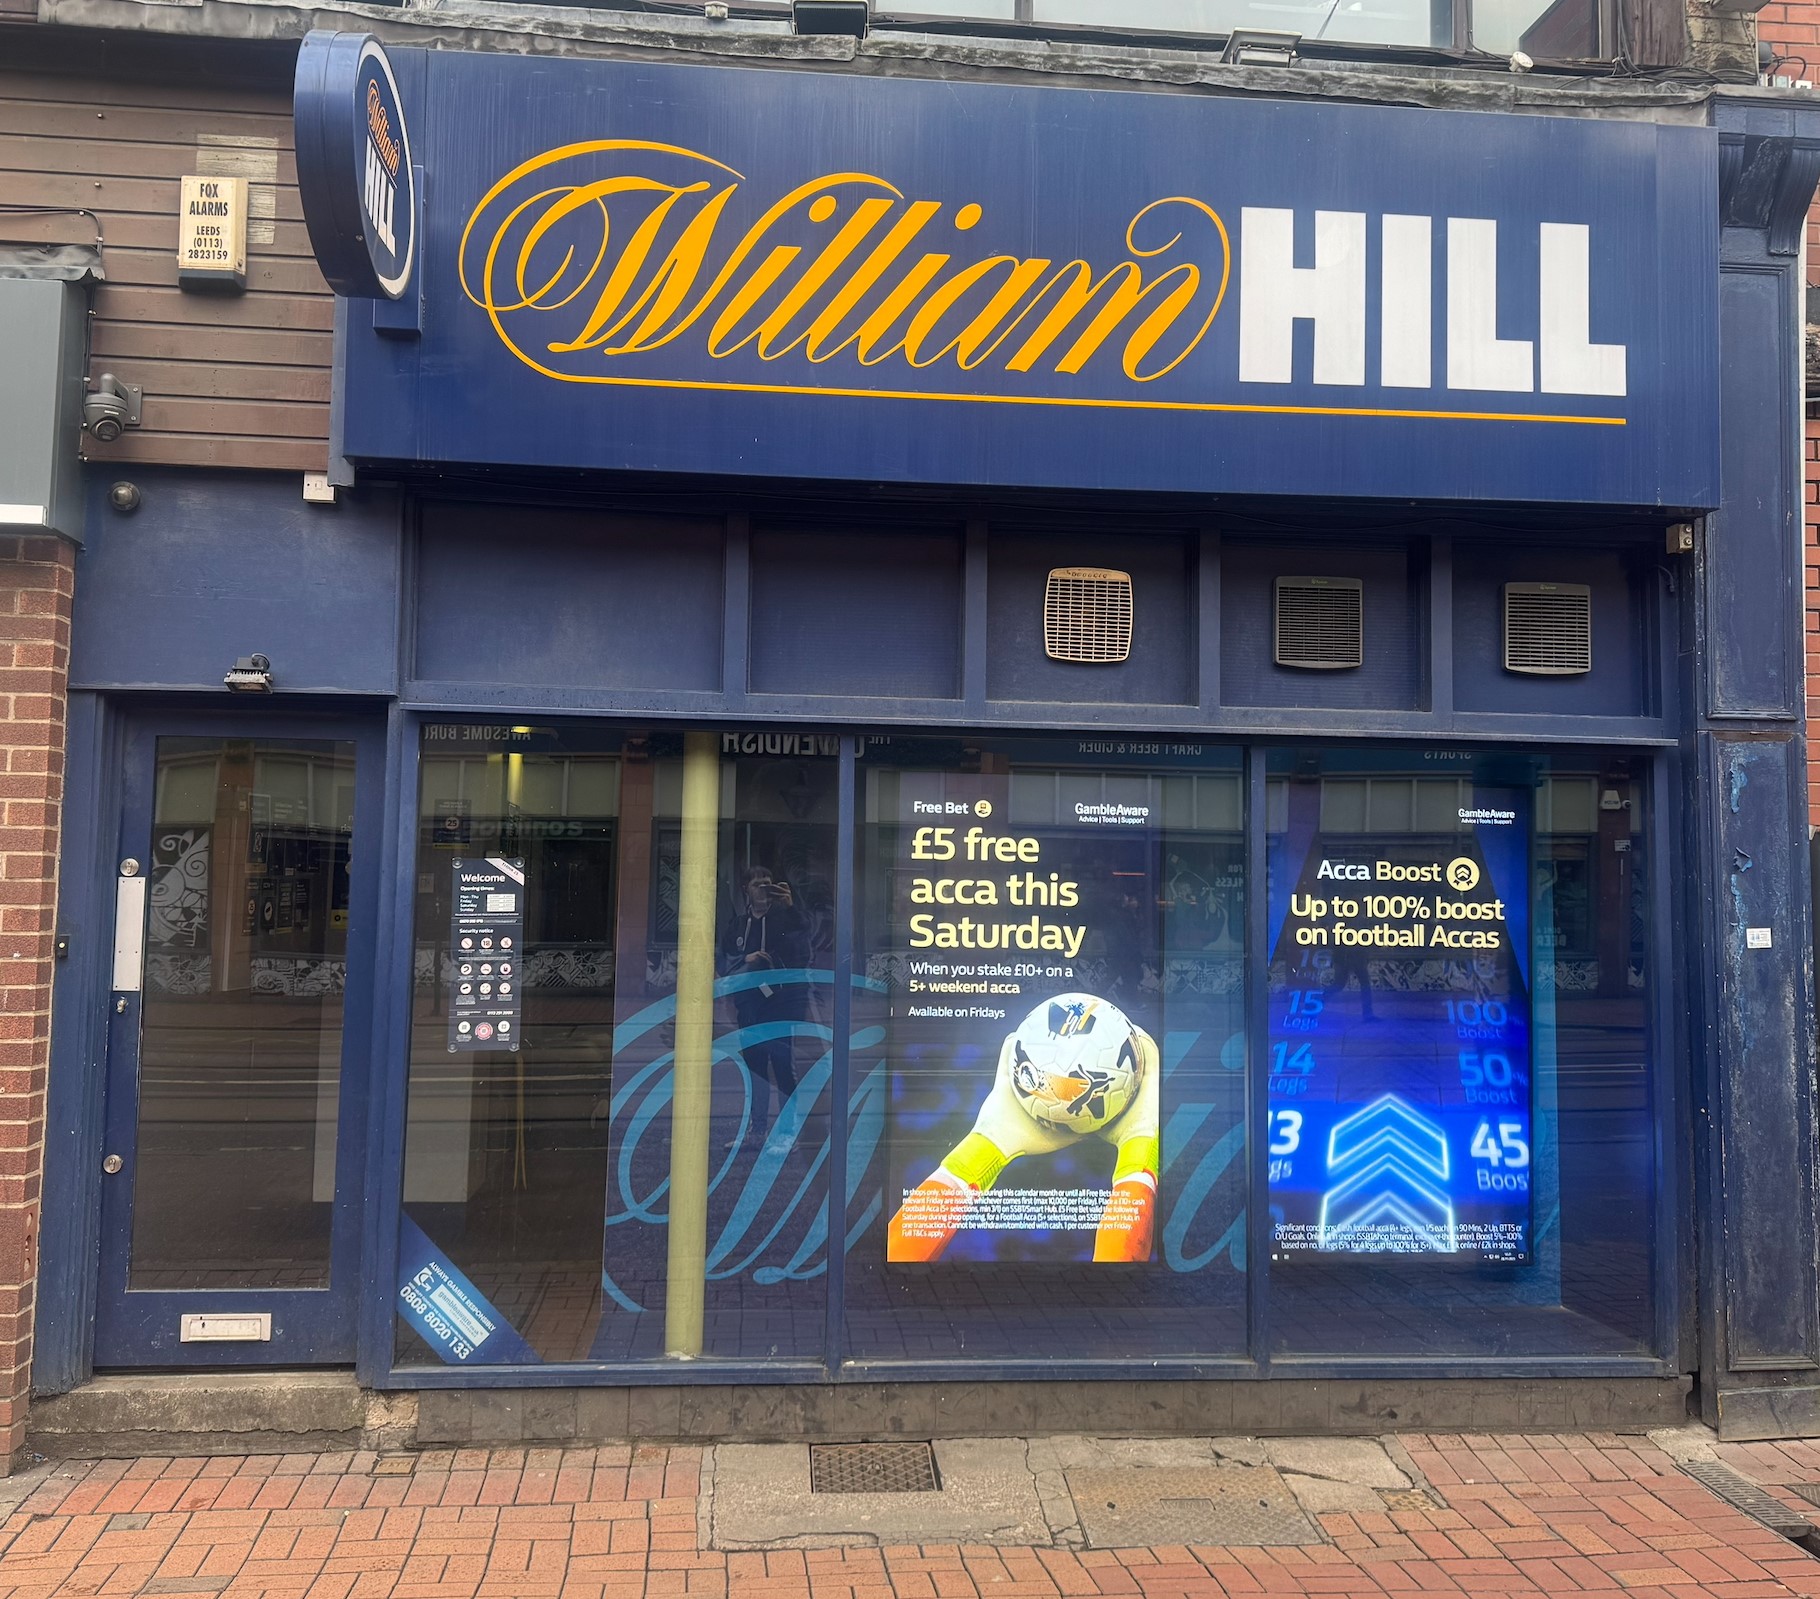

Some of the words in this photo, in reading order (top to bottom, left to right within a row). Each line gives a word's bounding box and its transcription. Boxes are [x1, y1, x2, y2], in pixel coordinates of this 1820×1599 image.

[367, 79, 401, 177] William
[200, 183, 219, 198] FOX
[364, 134, 396, 258] HILL
[189, 201, 228, 216] ALARMS
[196, 226, 220, 236] LEEDS
[188, 249, 228, 260] 2823159
[193, 237, 223, 249] (0113)
[459, 138, 1230, 382] William
[1239, 206, 1627, 396] HILL
[913, 801, 942, 814] Free
[945, 801, 969, 815] Bet
[1075, 802, 1149, 817] GambleAware
[1458, 808, 1515, 819] GambleAware
[1121, 816, 1145, 825] Support
[911, 826, 956, 861] £5
[963, 826, 1040, 863] free
[461, 873, 506, 882] Welcome
[1316, 859, 1371, 881] Acca
[1375, 860, 1442, 882] Boost
[910, 876, 999, 905] acca
[1005, 871, 1080, 907] this
[1290, 893, 1328, 922] Up
[1331, 895, 1359, 918] to
[1362, 895, 1431, 919] 100%
[1435, 896, 1505, 921] boost
[909, 913, 1087, 959] Saturday
[1295, 926, 1328, 946] on
[1332, 922, 1426, 947] football
[1429, 925, 1500, 949] Accas
[910, 961, 948, 975] When
[951, 965, 975, 978] you
[977, 963, 1012, 976] stake
[1013, 964, 1043, 977] £10+
[1046, 966, 1062, 977] on
[1064, 967, 1073, 977] a
[909, 979, 926, 992] 5+
[929, 980, 987, 993] weekend
[990, 983, 1020, 994] acca
[908, 1006, 953, 1017] Available
[955, 1008, 968, 1017] on
[969, 1007, 1006, 1020] Fridays
[1288, 990, 1324, 1015] 15
[1272, 1041, 1315, 1074] 14
[1470, 1123, 1529, 1169] 45
[429, 1261, 450, 1284] ALWAYS
[447, 1280, 468, 1301] GAMBLE
[400, 1286, 427, 1315] 0808
[424, 1311, 452, 1340] 8020
[448, 1336, 470, 1360] 133
